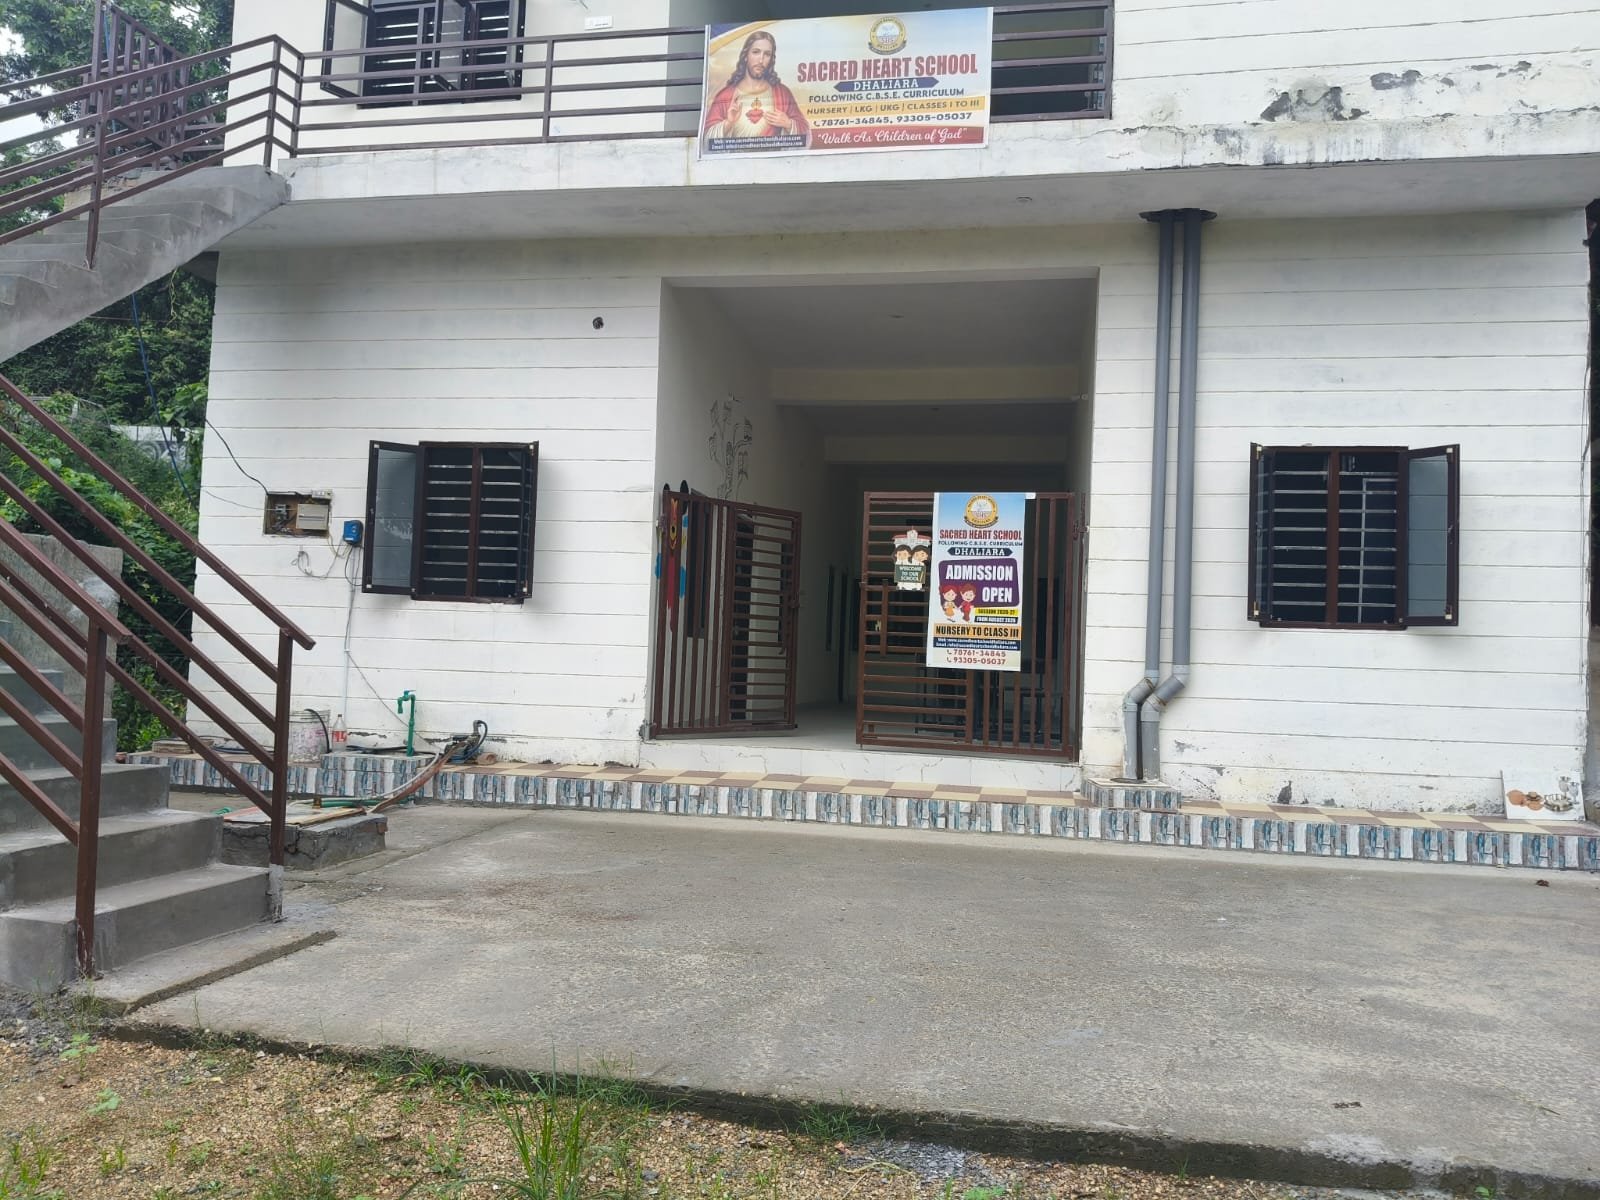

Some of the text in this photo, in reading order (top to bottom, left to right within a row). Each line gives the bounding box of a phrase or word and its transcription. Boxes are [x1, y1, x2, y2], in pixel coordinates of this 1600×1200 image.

[797, 54, 978, 83] SACRED HEART SCHOOL
[853, 79, 919, 91] DHALIARA
[808, 88, 964, 103] FOLLOWING C.B.S.E. CURRICULUM
[807, 106, 848, 115] NURSERY
[854, 105, 873, 113] LKG
[880, 104, 900, 112] UKG
[908, 102, 948, 111] CLASSES
[896, 112, 973, 124] 93305-05037
[853, 132, 872, 143] As
[874, 129, 922, 143] Children
[924, 130, 935, 143] of
[940, 529, 1022, 540] SACRED HEART SCHOOL
[954, 548, 1005, 556] DHALIARA
[945, 564, 1013, 581] ADMISSION
[982, 586, 1013, 603] OPEN
[936, 625, 1019, 638] NURSERY TO CLASS III
[954, 657, 1006, 665] 93305-05037
